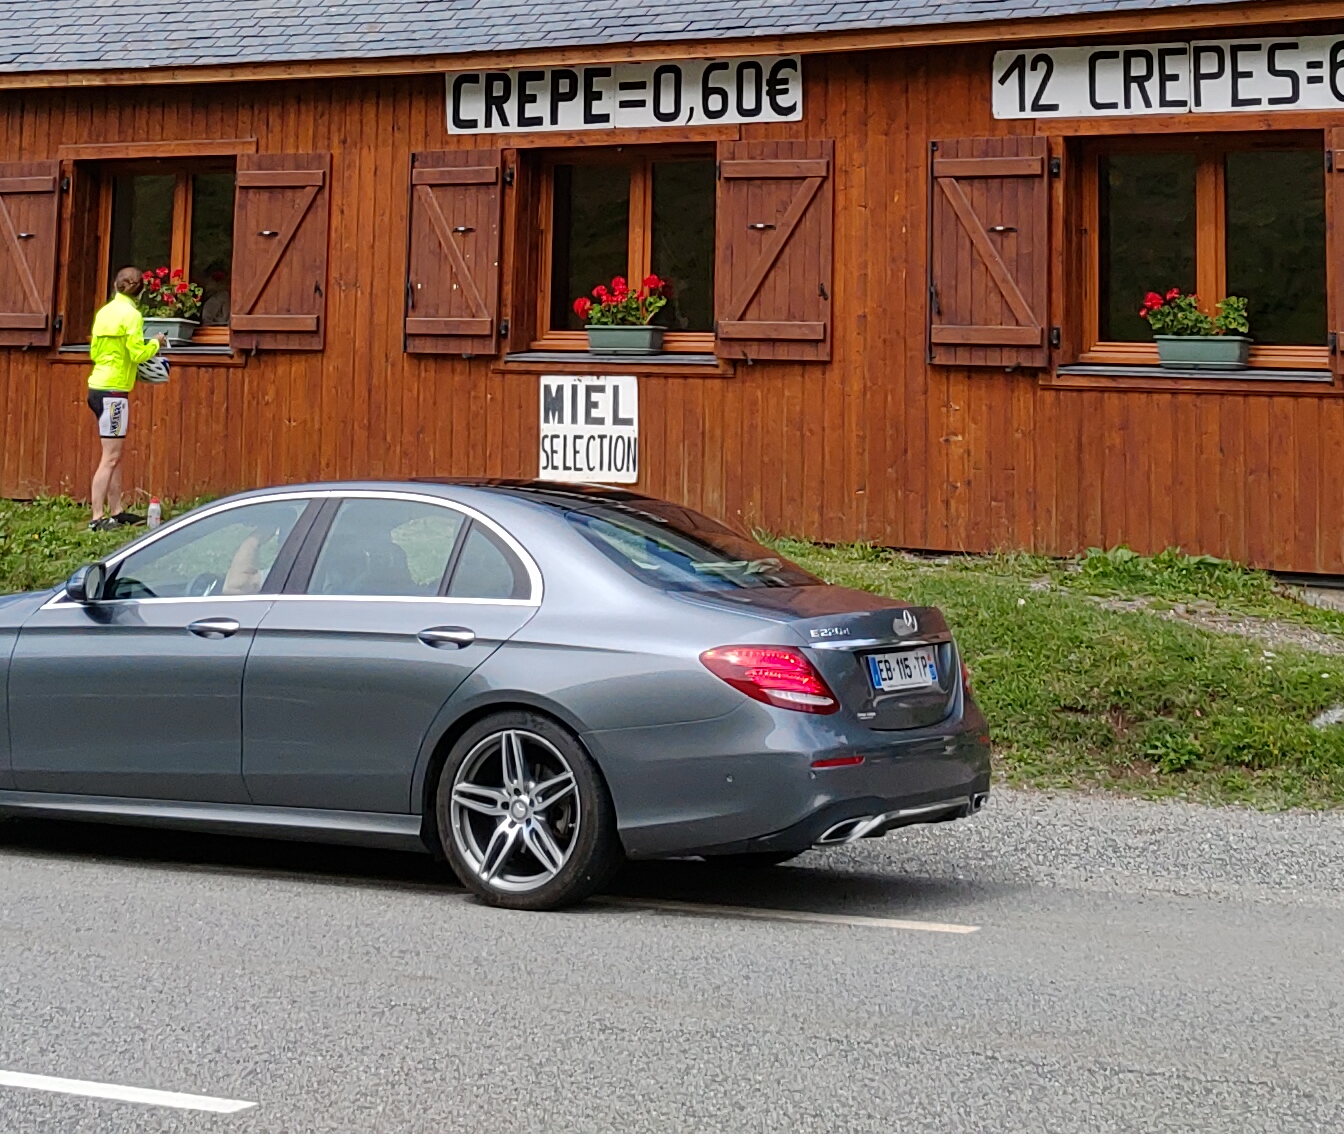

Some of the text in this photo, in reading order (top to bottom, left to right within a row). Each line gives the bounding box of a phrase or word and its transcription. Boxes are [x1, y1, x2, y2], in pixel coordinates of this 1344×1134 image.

[452, 58, 798, 129] CREPE=0,60€
[998, 53, 1059, 112] 12
[543, 384, 634, 426] MIEL
[541, 434, 637, 472] SELECTION
